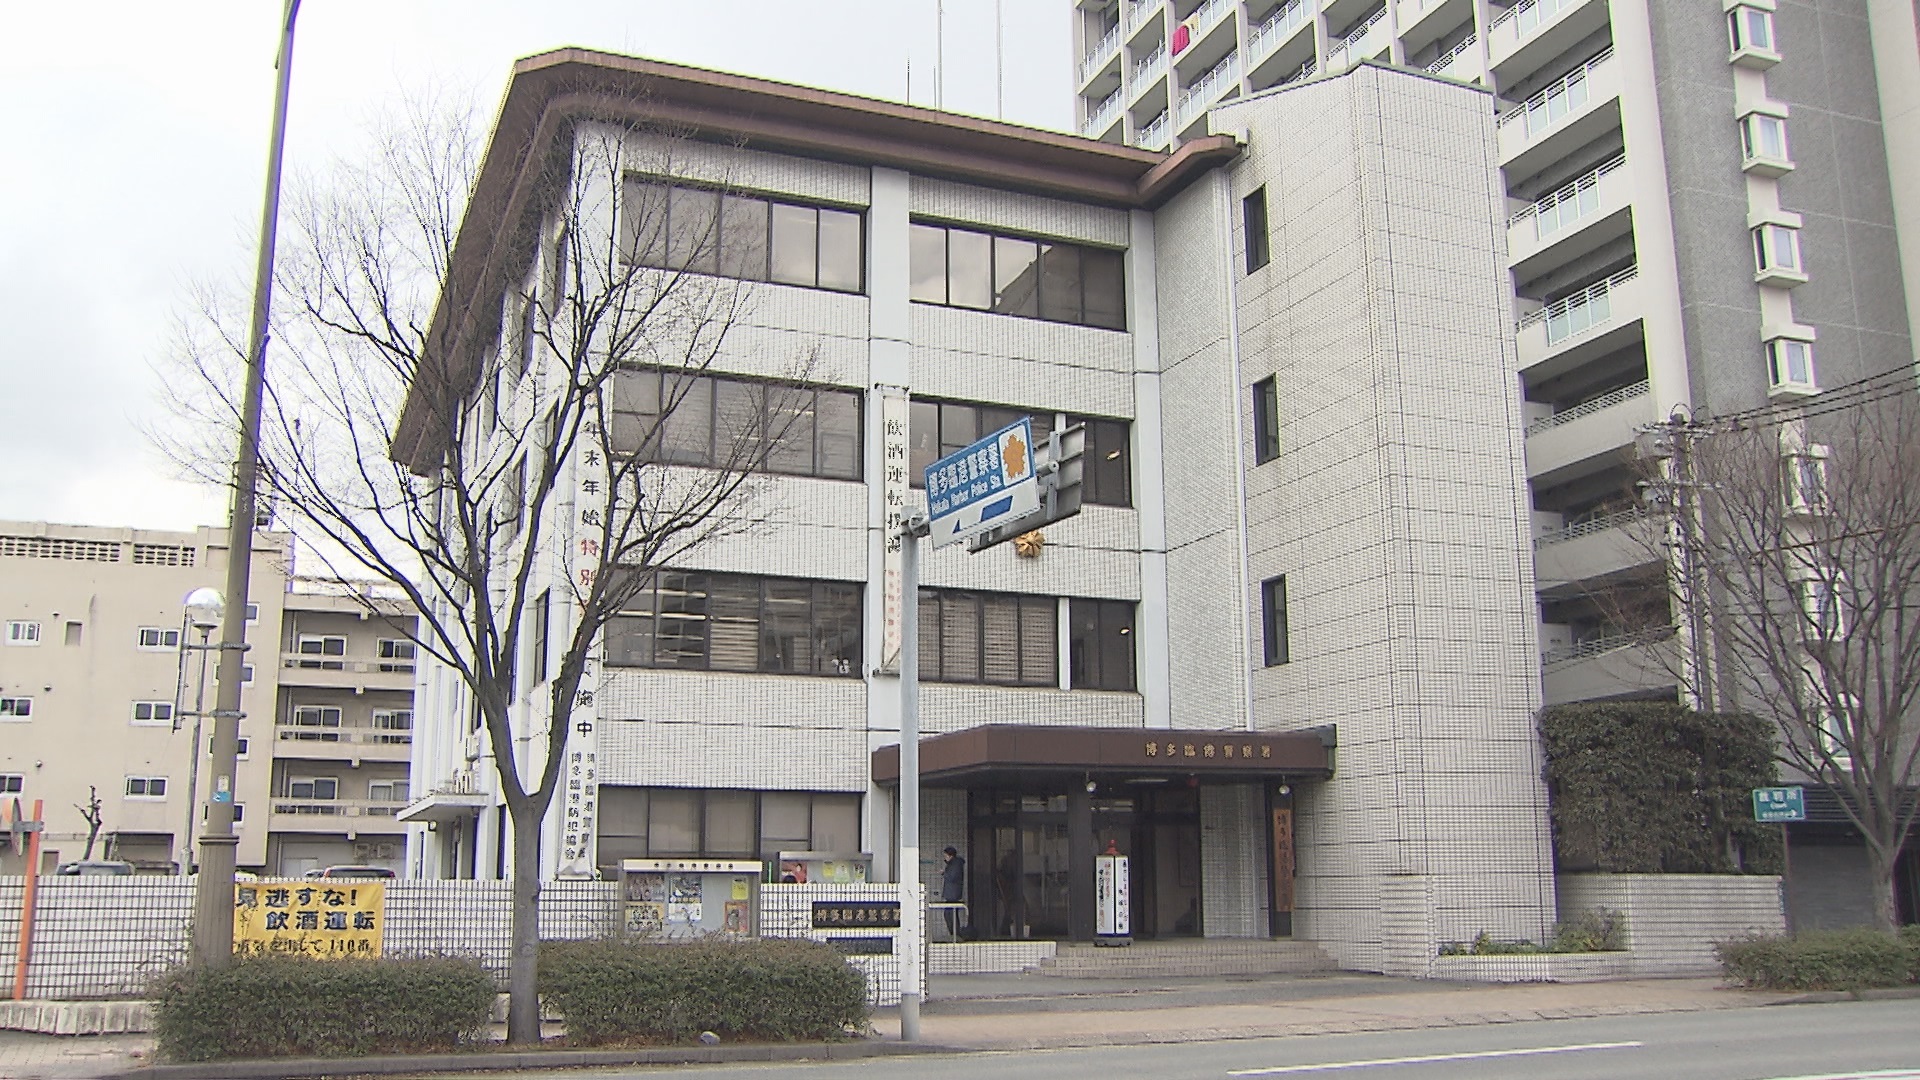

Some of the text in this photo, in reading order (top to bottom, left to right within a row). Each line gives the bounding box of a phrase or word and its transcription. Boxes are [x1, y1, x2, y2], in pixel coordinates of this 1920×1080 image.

[576, 421, 601, 738] 年末年始特別施中
[265, 911, 376, 931] 飲酒運転
